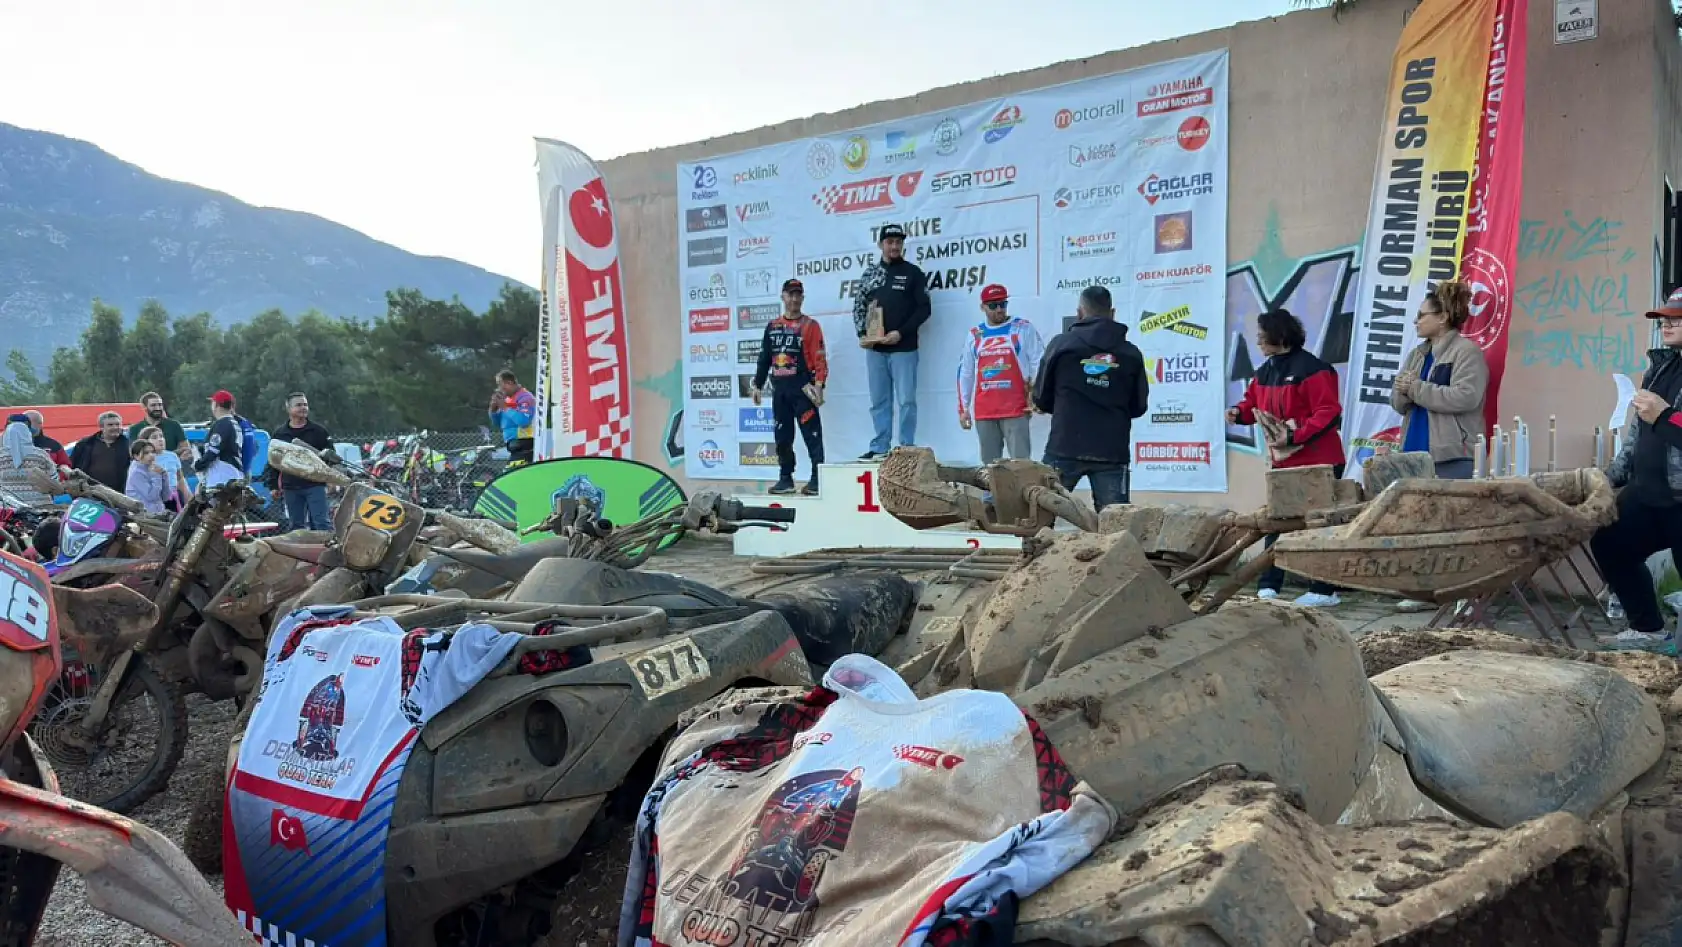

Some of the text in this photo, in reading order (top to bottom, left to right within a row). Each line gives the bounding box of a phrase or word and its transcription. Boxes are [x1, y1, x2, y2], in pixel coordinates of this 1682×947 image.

[1159, 75, 1204, 95] YAMAHA
[1056, 98, 1124, 126] motorall
[1171, 92, 1207, 110] MOTOR
[1395, 56, 1436, 149] SPOR
[843, 182, 888, 205] TMF
[1161, 186, 1213, 201] MOTOR
[1377, 158, 1424, 277] ORMAN
[870, 216, 942, 244] TKİYE
[796, 232, 1028, 277] ENDURO VE ŞAMPİYONASI
[1057, 275, 1121, 290] Ahmet Koca
[1136, 263, 1213, 281] OBEN KUAFÖR
[1173, 323, 1206, 339] MOTOR
[1359, 284, 1410, 404] FETHİYE
[1165, 352, 1210, 370] YİĞİT
[1165, 369, 1209, 384] BETON
[857, 470, 880, 512] 1
[71, 503, 98, 522] 22
[361, 500, 402, 527] 73
[637, 644, 700, 690] 877
